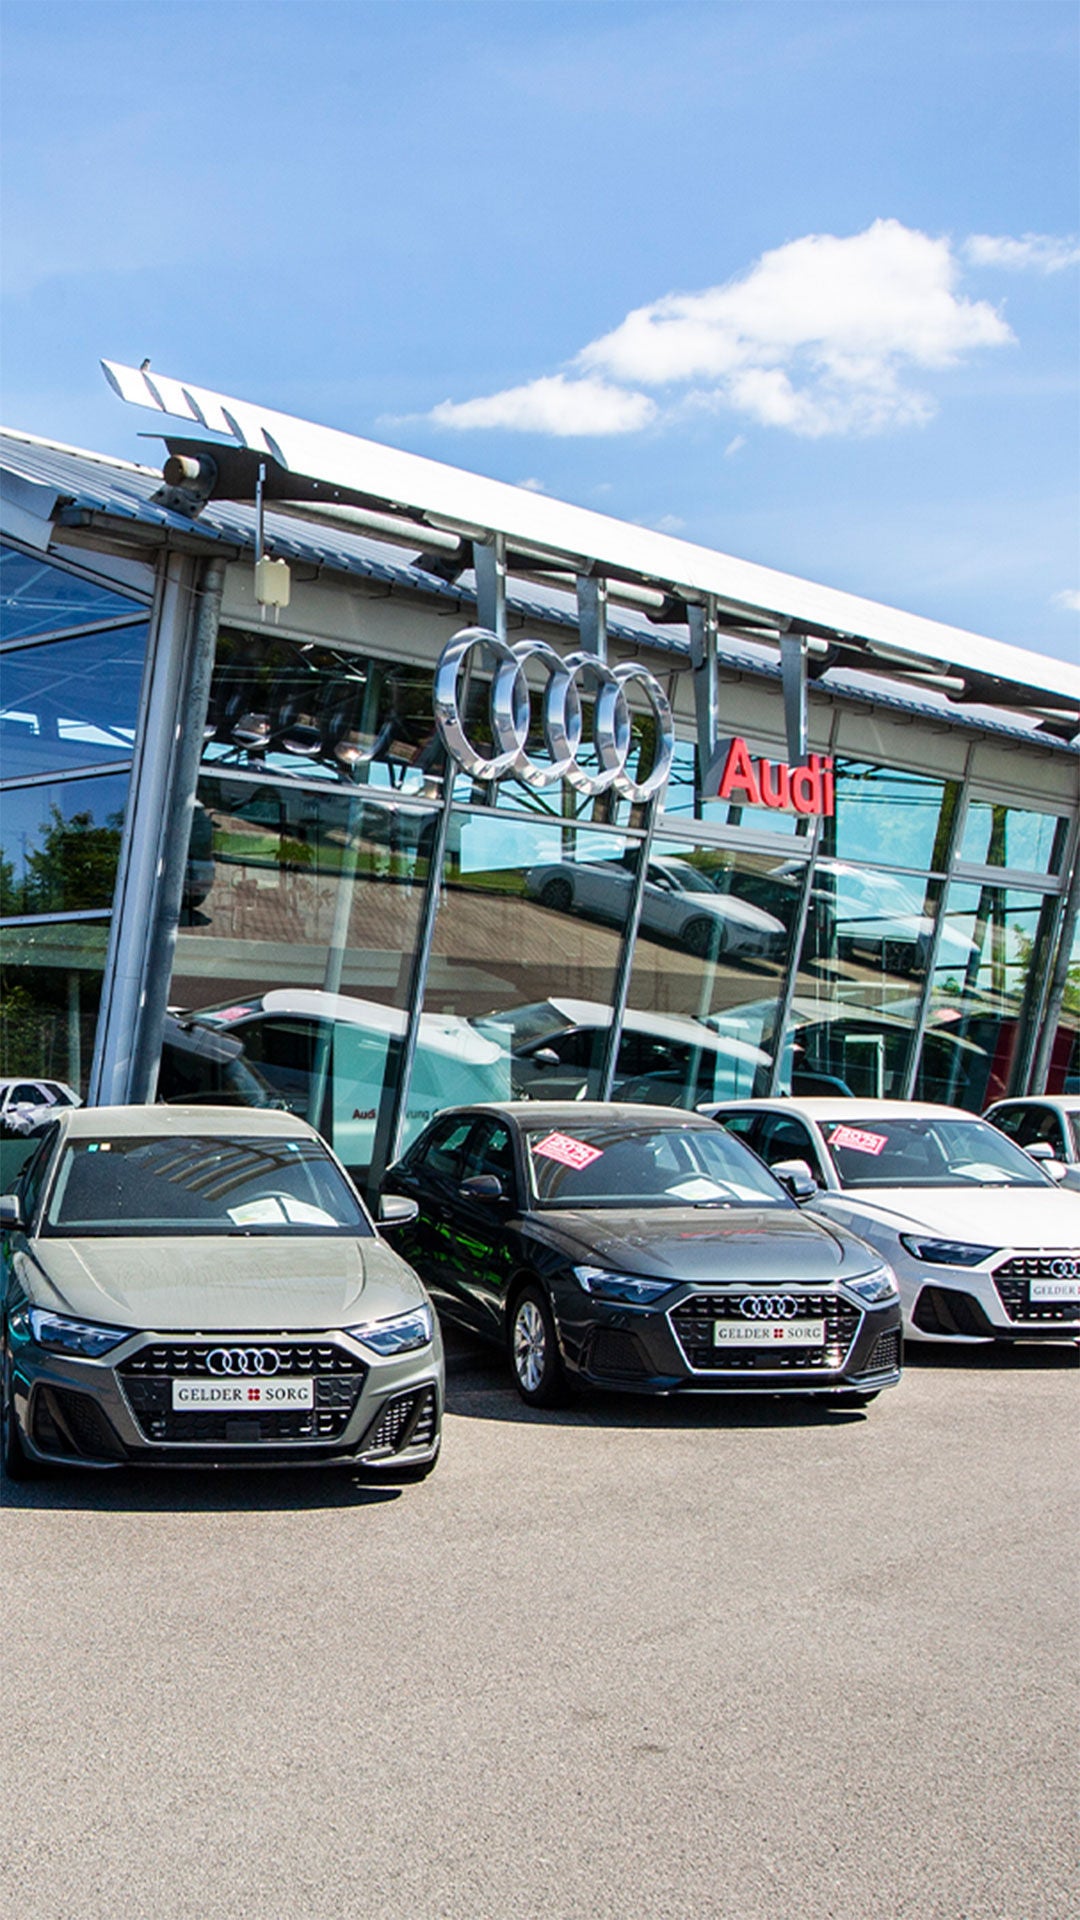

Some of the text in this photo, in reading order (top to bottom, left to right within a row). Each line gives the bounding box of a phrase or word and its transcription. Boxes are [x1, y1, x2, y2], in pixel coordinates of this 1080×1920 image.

[717, 736, 834, 816] Audi
[1033, 1286, 1076, 1296] GELDER
[718, 1327, 821, 1339] GELDER SORG
[178, 1387, 309, 1401] GELDER SORG
